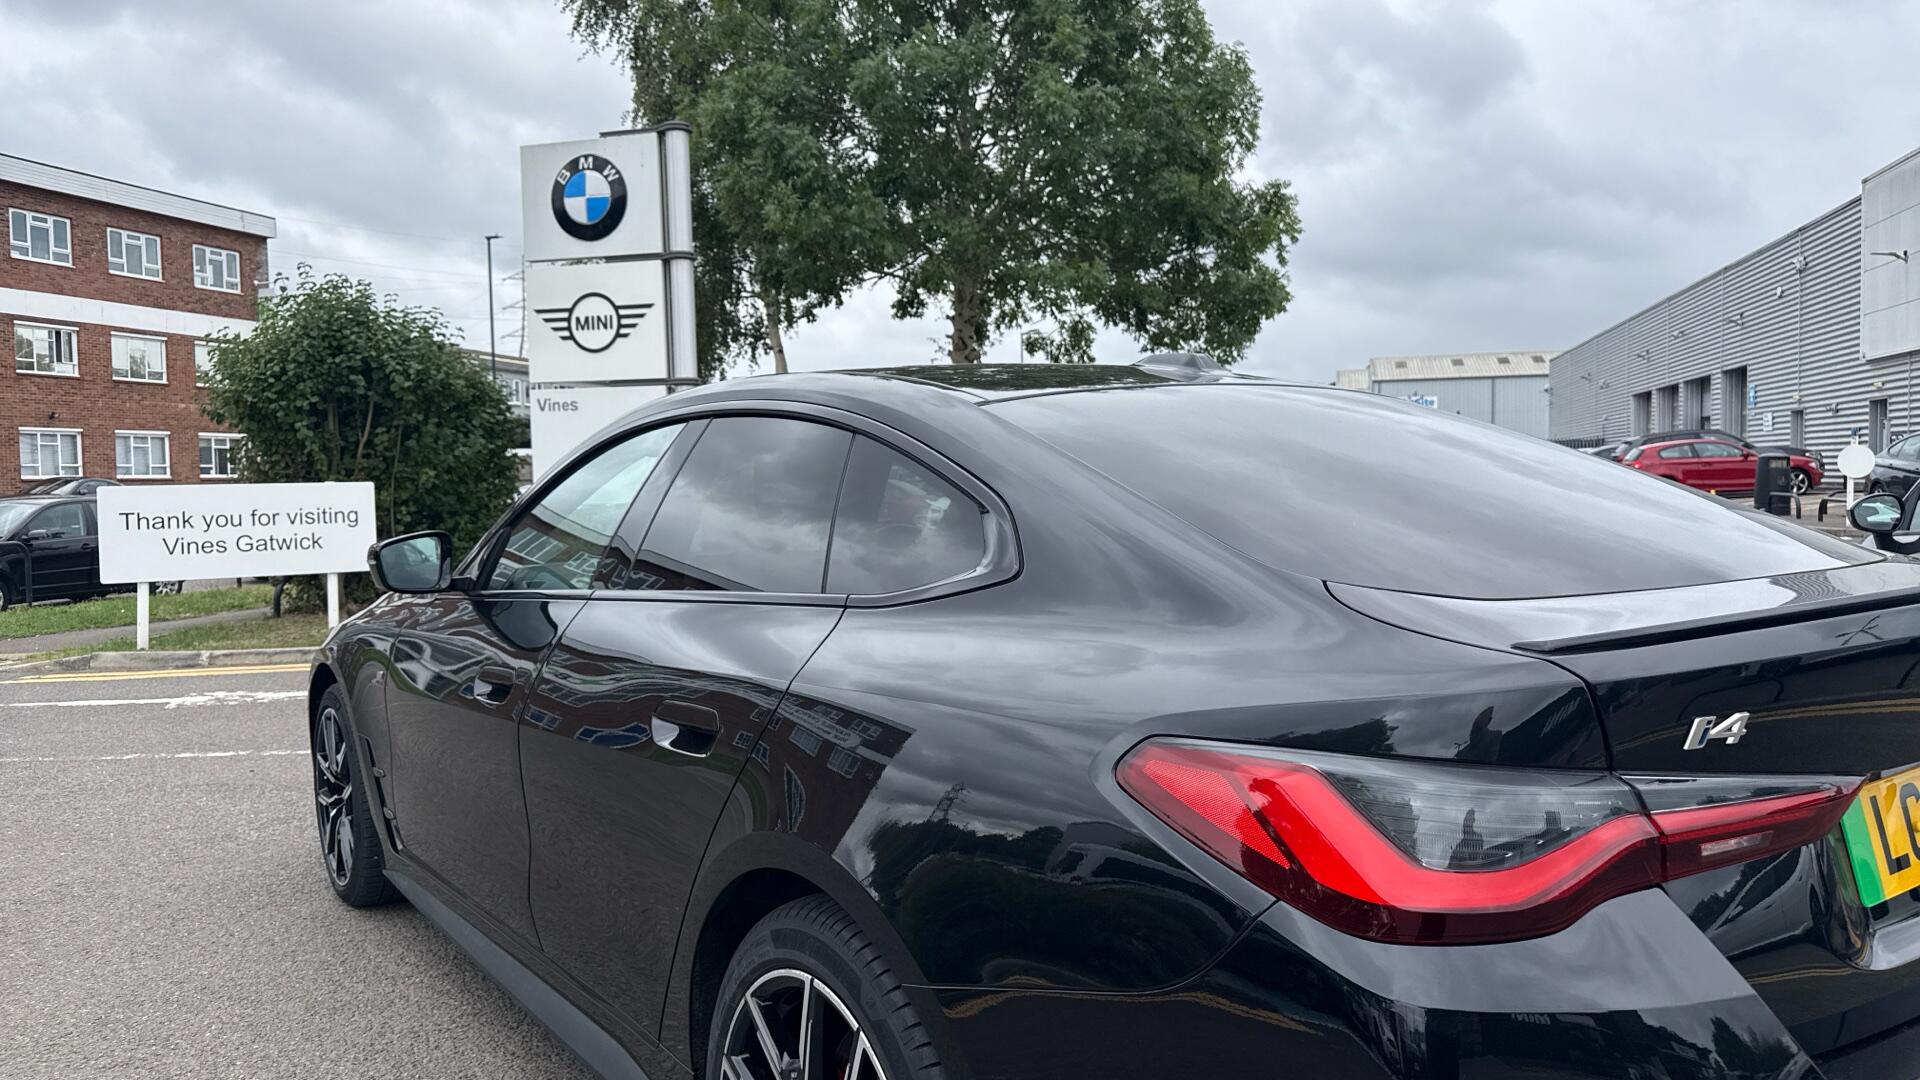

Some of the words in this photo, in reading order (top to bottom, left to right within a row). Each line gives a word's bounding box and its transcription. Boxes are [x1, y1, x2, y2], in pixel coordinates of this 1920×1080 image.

[557, 156, 619, 185] BMW
[575, 314, 613, 331] MINI
[537, 398, 578, 412] Vines
[119, 511, 194, 530] Thank
[202, 513, 242, 532] you
[250, 509, 280, 526] for
[287, 507, 359, 527] visiting
[162, 537, 227, 555] Vines
[236, 533, 323, 552] Gatwick
